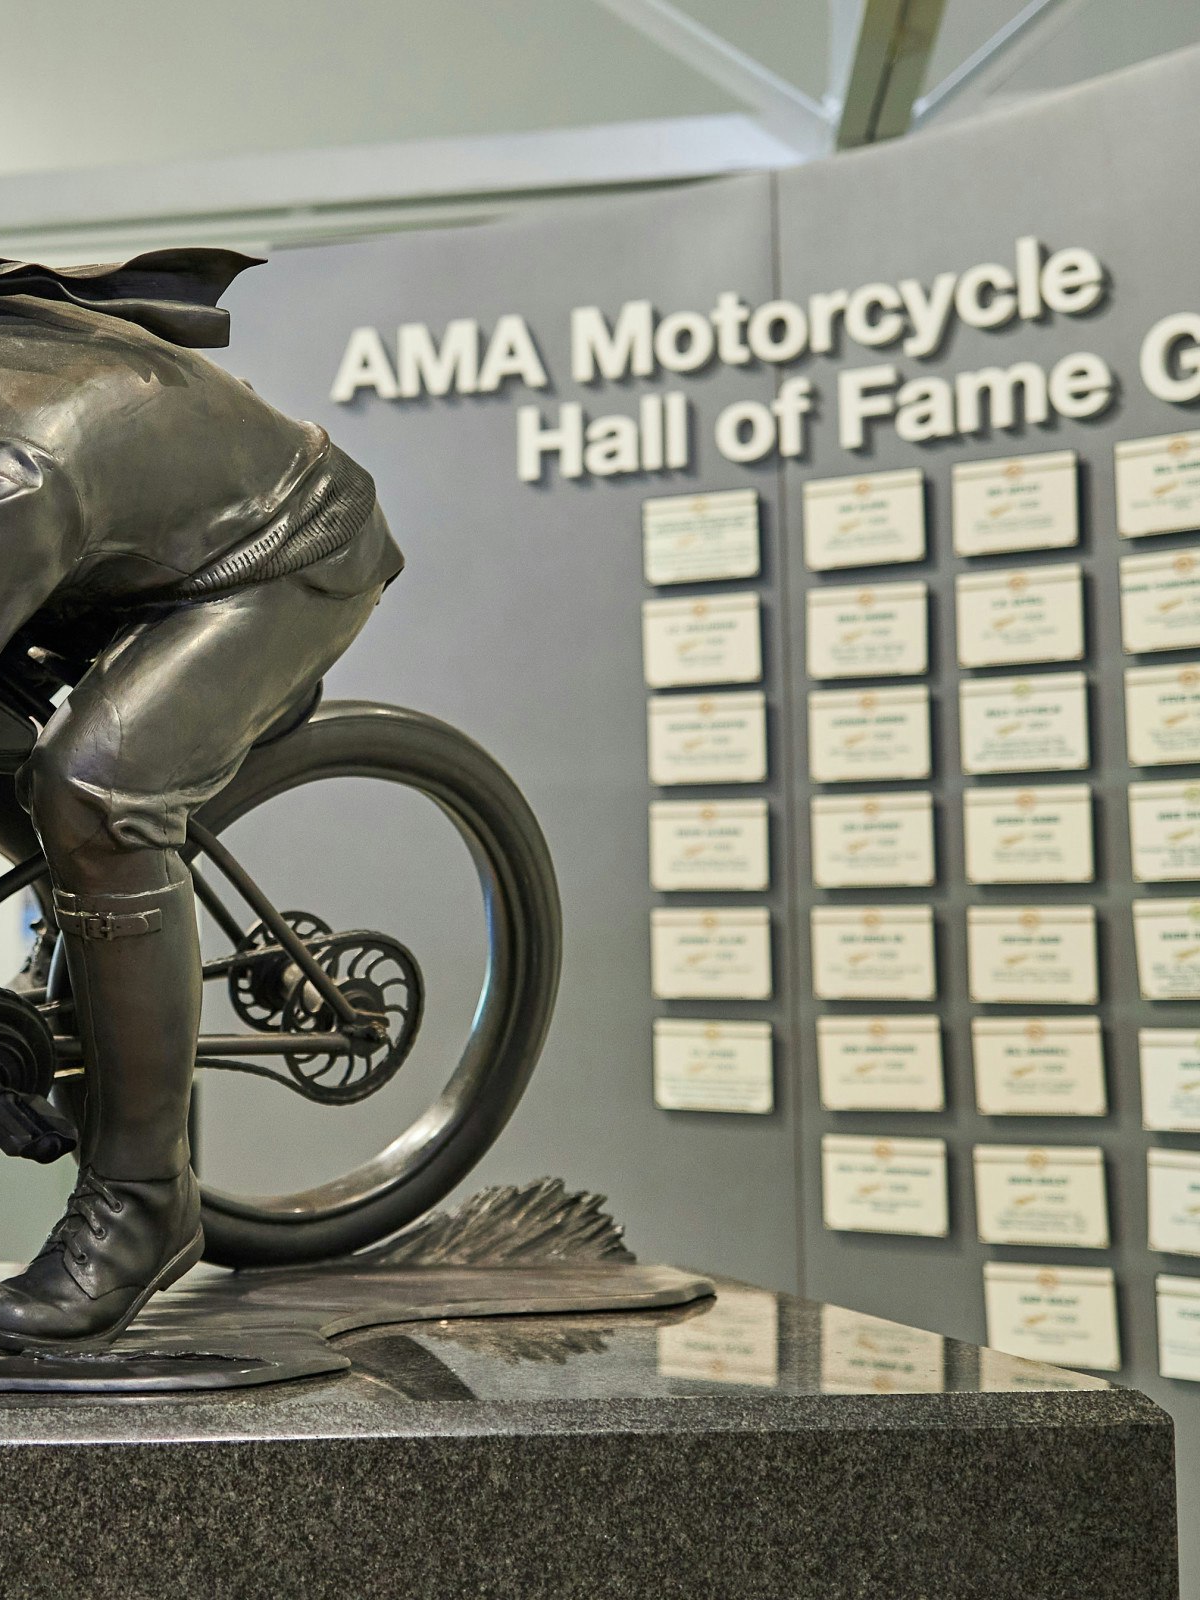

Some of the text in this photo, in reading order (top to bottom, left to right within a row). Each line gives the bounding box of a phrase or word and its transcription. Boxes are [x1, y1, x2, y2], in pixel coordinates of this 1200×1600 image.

[331, 237, 1102, 402] AMA Motorcycle
[517, 352, 1112, 481] Hall of Fame
